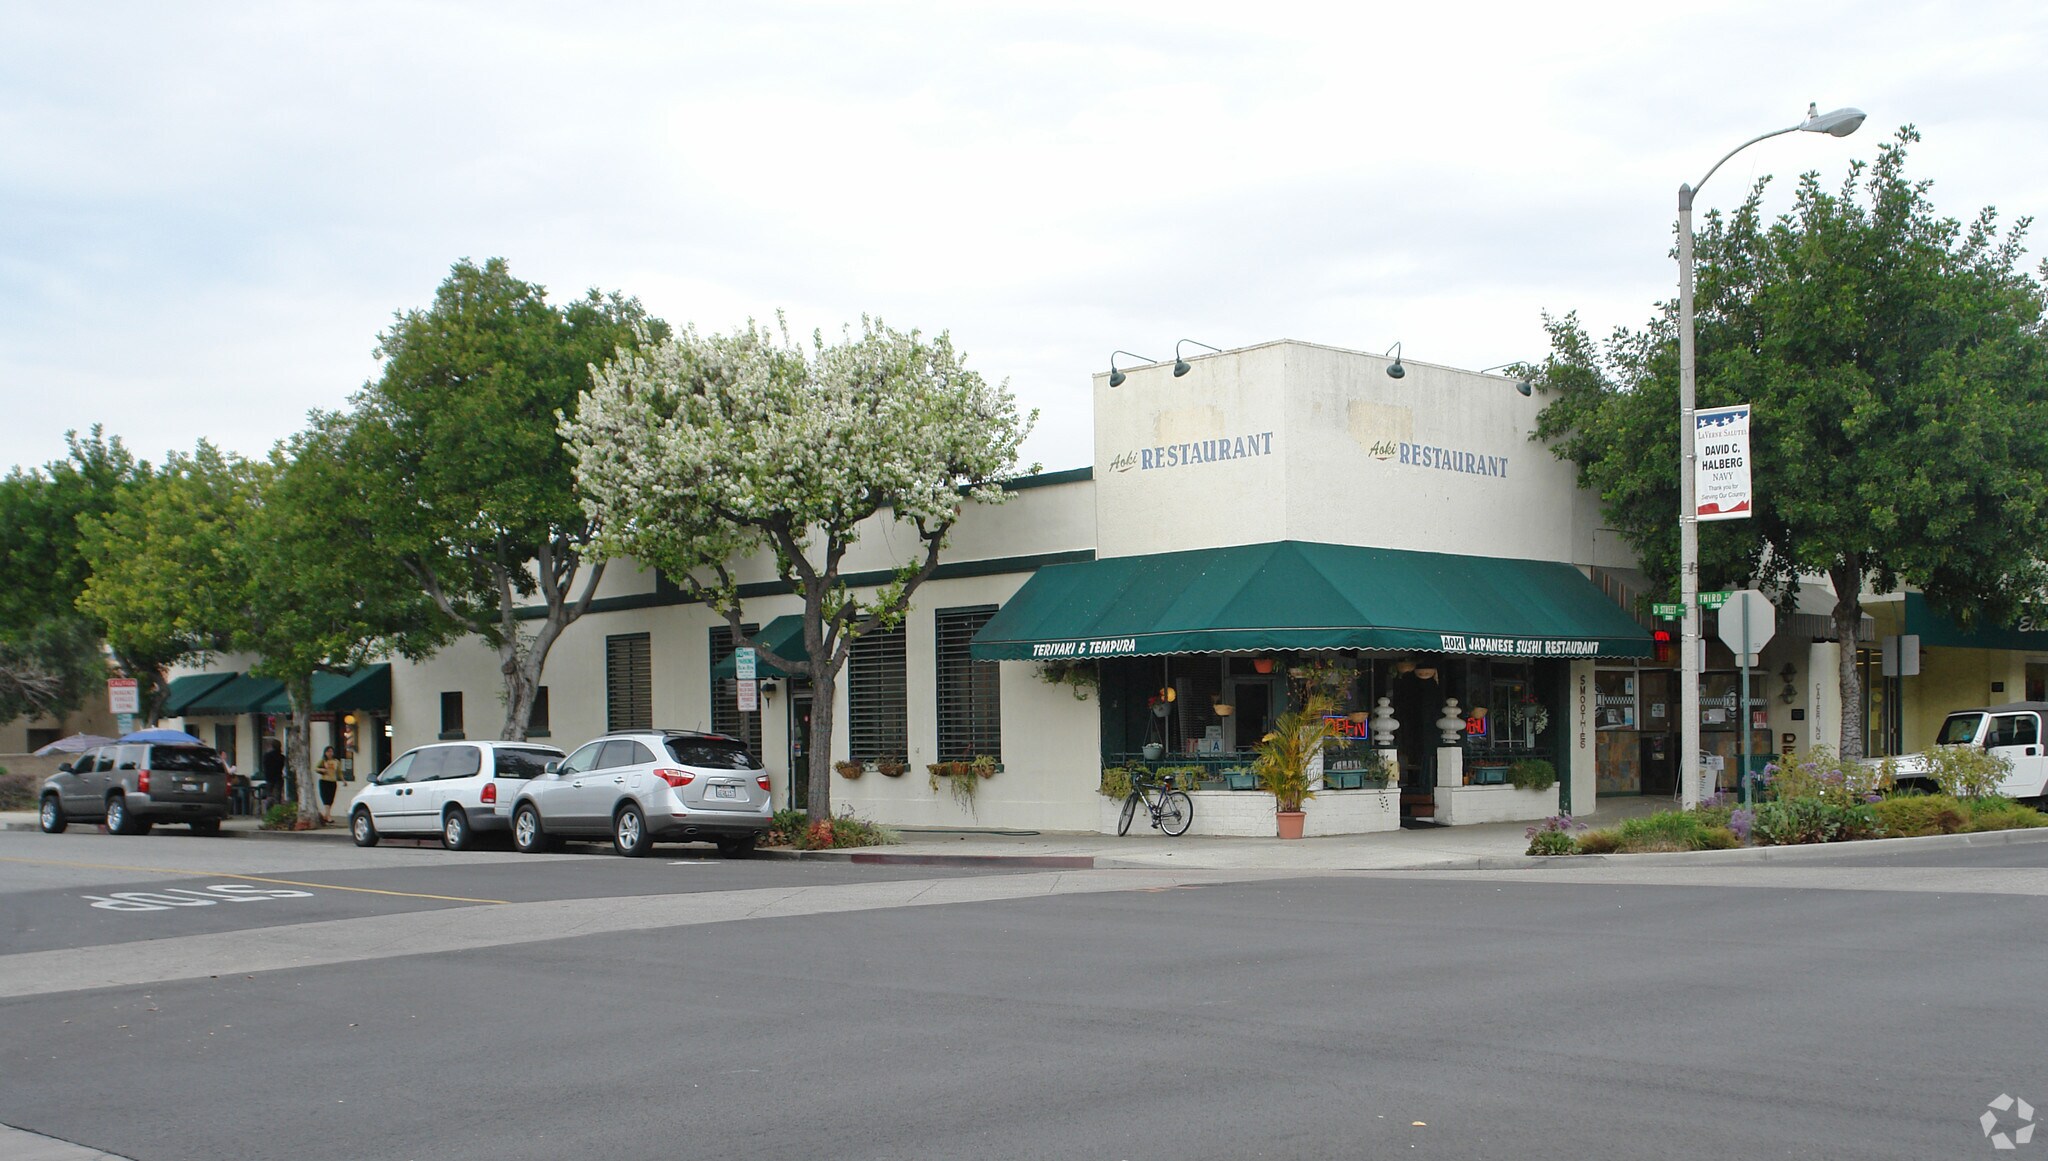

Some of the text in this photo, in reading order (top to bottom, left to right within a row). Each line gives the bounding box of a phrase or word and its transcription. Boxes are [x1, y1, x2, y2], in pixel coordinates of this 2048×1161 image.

[1109, 432, 1274, 472] Aoki RESTAURANT
[1705, 443, 1741, 456] DAVID C.
[1368, 440, 1508, 478] Aoki RESTAURANT
[1702, 457, 1743, 471] HALBERG
[1712, 472, 1734, 482] NAVY
[1699, 594, 1721, 602] THIRD
[1653, 605, 1676, 614] D STREET
[1033, 639, 1136, 656] TERIYAKI & TEMPURA
[1443, 636, 1600, 655] AOKI JAPANESE SUSHI RESTAURANT
[1213, 741, 1220, 751] A
[81, 884, 314, 911] STOP
